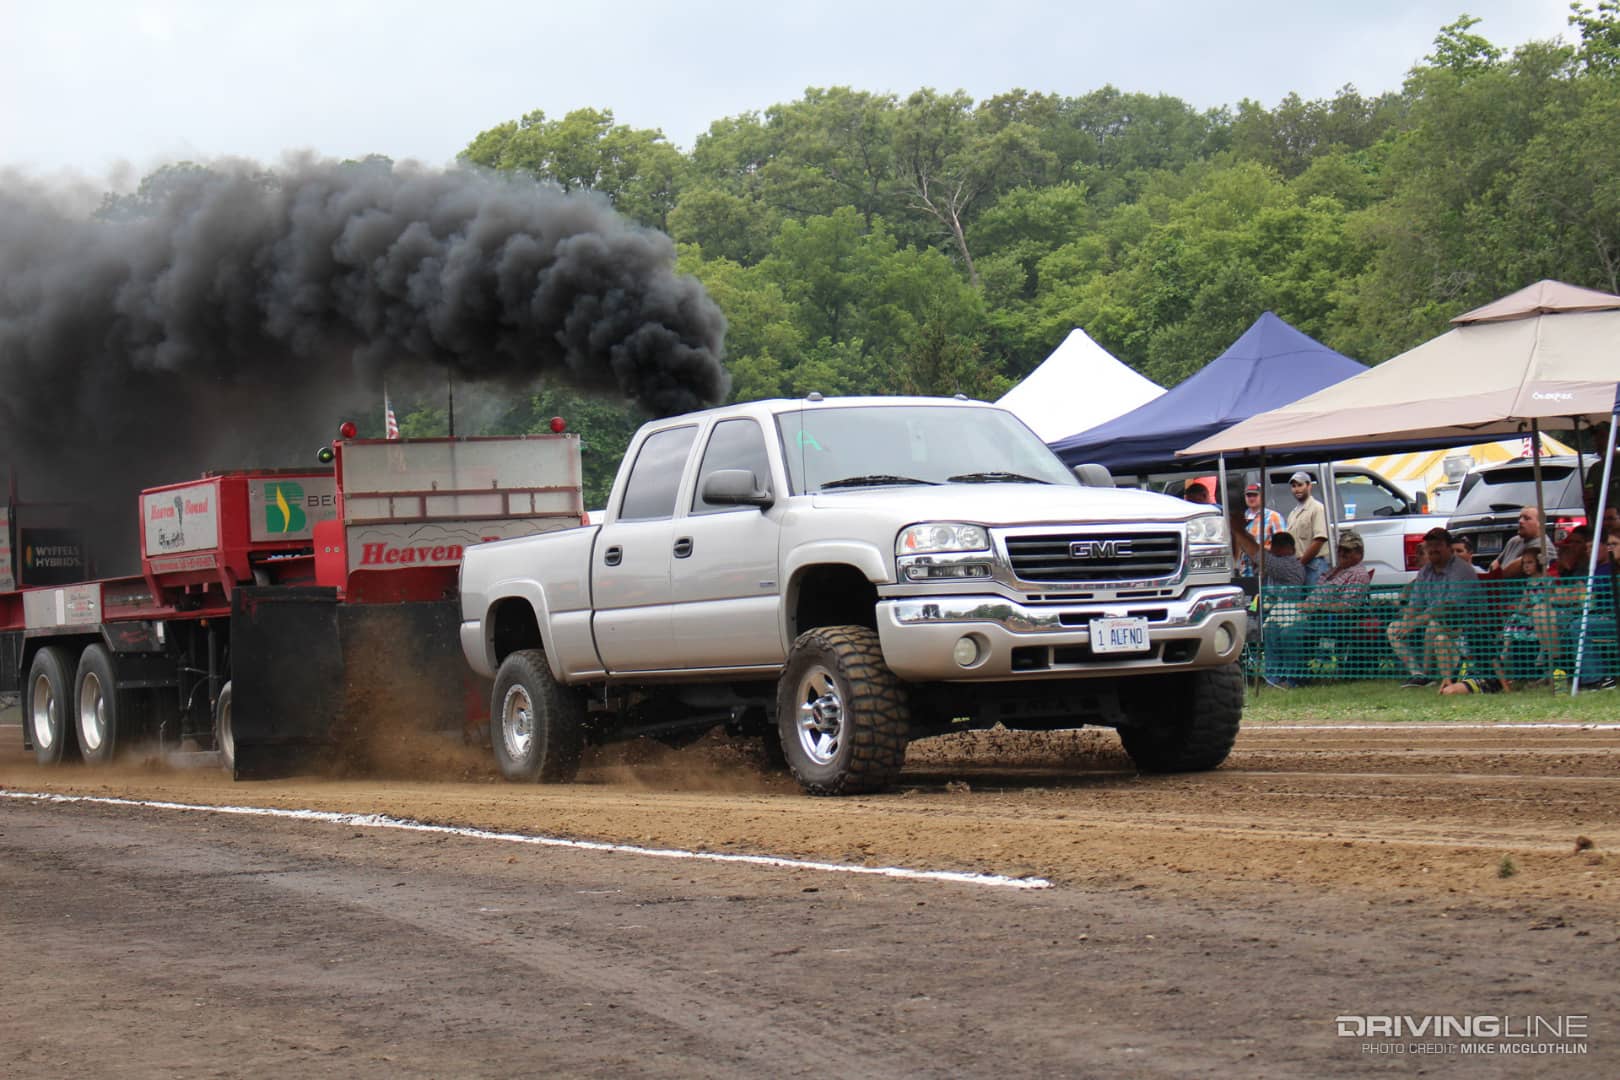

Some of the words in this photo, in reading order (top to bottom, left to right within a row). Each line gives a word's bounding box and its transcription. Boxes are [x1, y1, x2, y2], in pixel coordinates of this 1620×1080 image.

[307, 495, 337, 507] BE
[359, 541, 465, 566] Heaven
[1068, 540, 1132, 559] GMC
[35, 557, 80, 567] HYBRIDS
[1098, 629, 1104, 646] 1
